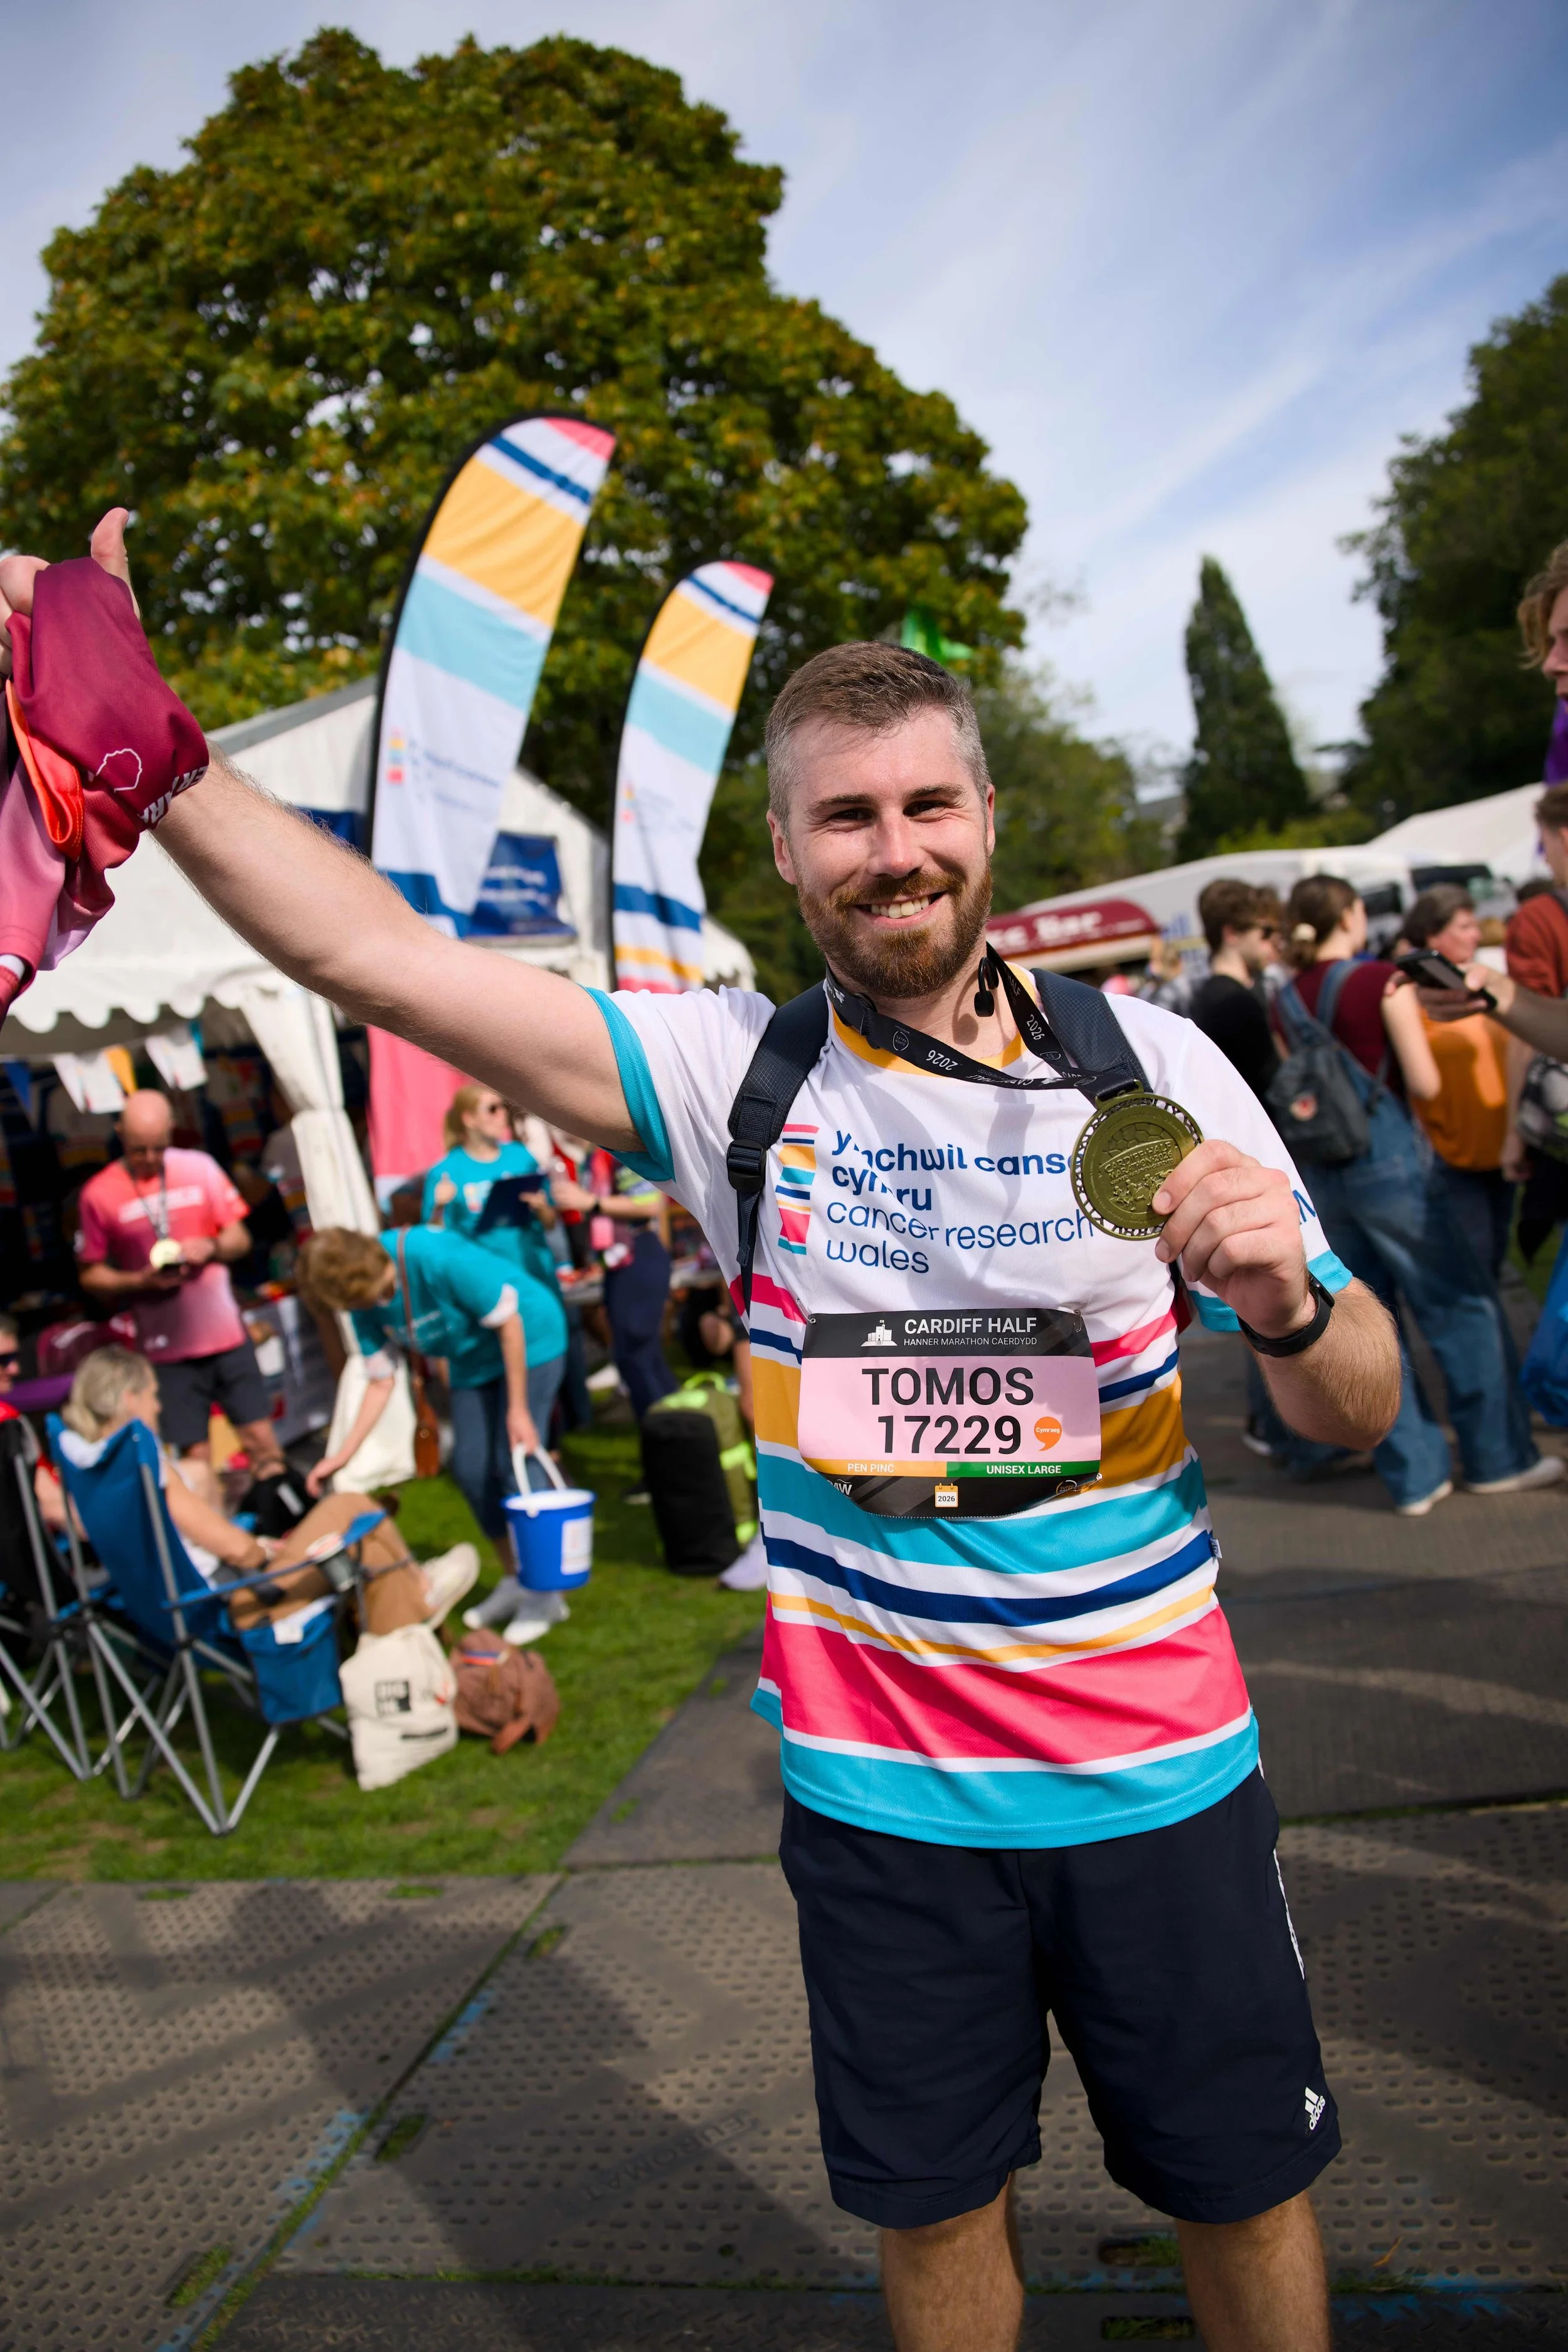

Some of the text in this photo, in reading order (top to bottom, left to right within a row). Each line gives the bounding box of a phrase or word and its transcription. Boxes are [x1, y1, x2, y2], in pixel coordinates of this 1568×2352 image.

[1026, 1014, 1046, 1041] 2026
[926, 1049, 958, 1071] 2026
[827, 1202, 940, 1241] cancer
[946, 1209, 1094, 1250] research
[826, 1239, 929, 1274] wales
[904, 1317, 1037, 1335] CARDIFF HALF
[904, 1337, 1037, 1346] HANNER MARATHON CAERDYDD
[862, 1367, 1034, 1406] TOMOS
[877, 1414, 1021, 1454] 17229
[847, 1463, 894, 1473] PEN PINC
[987, 1465, 1062, 1475] UNISEX LARGE
